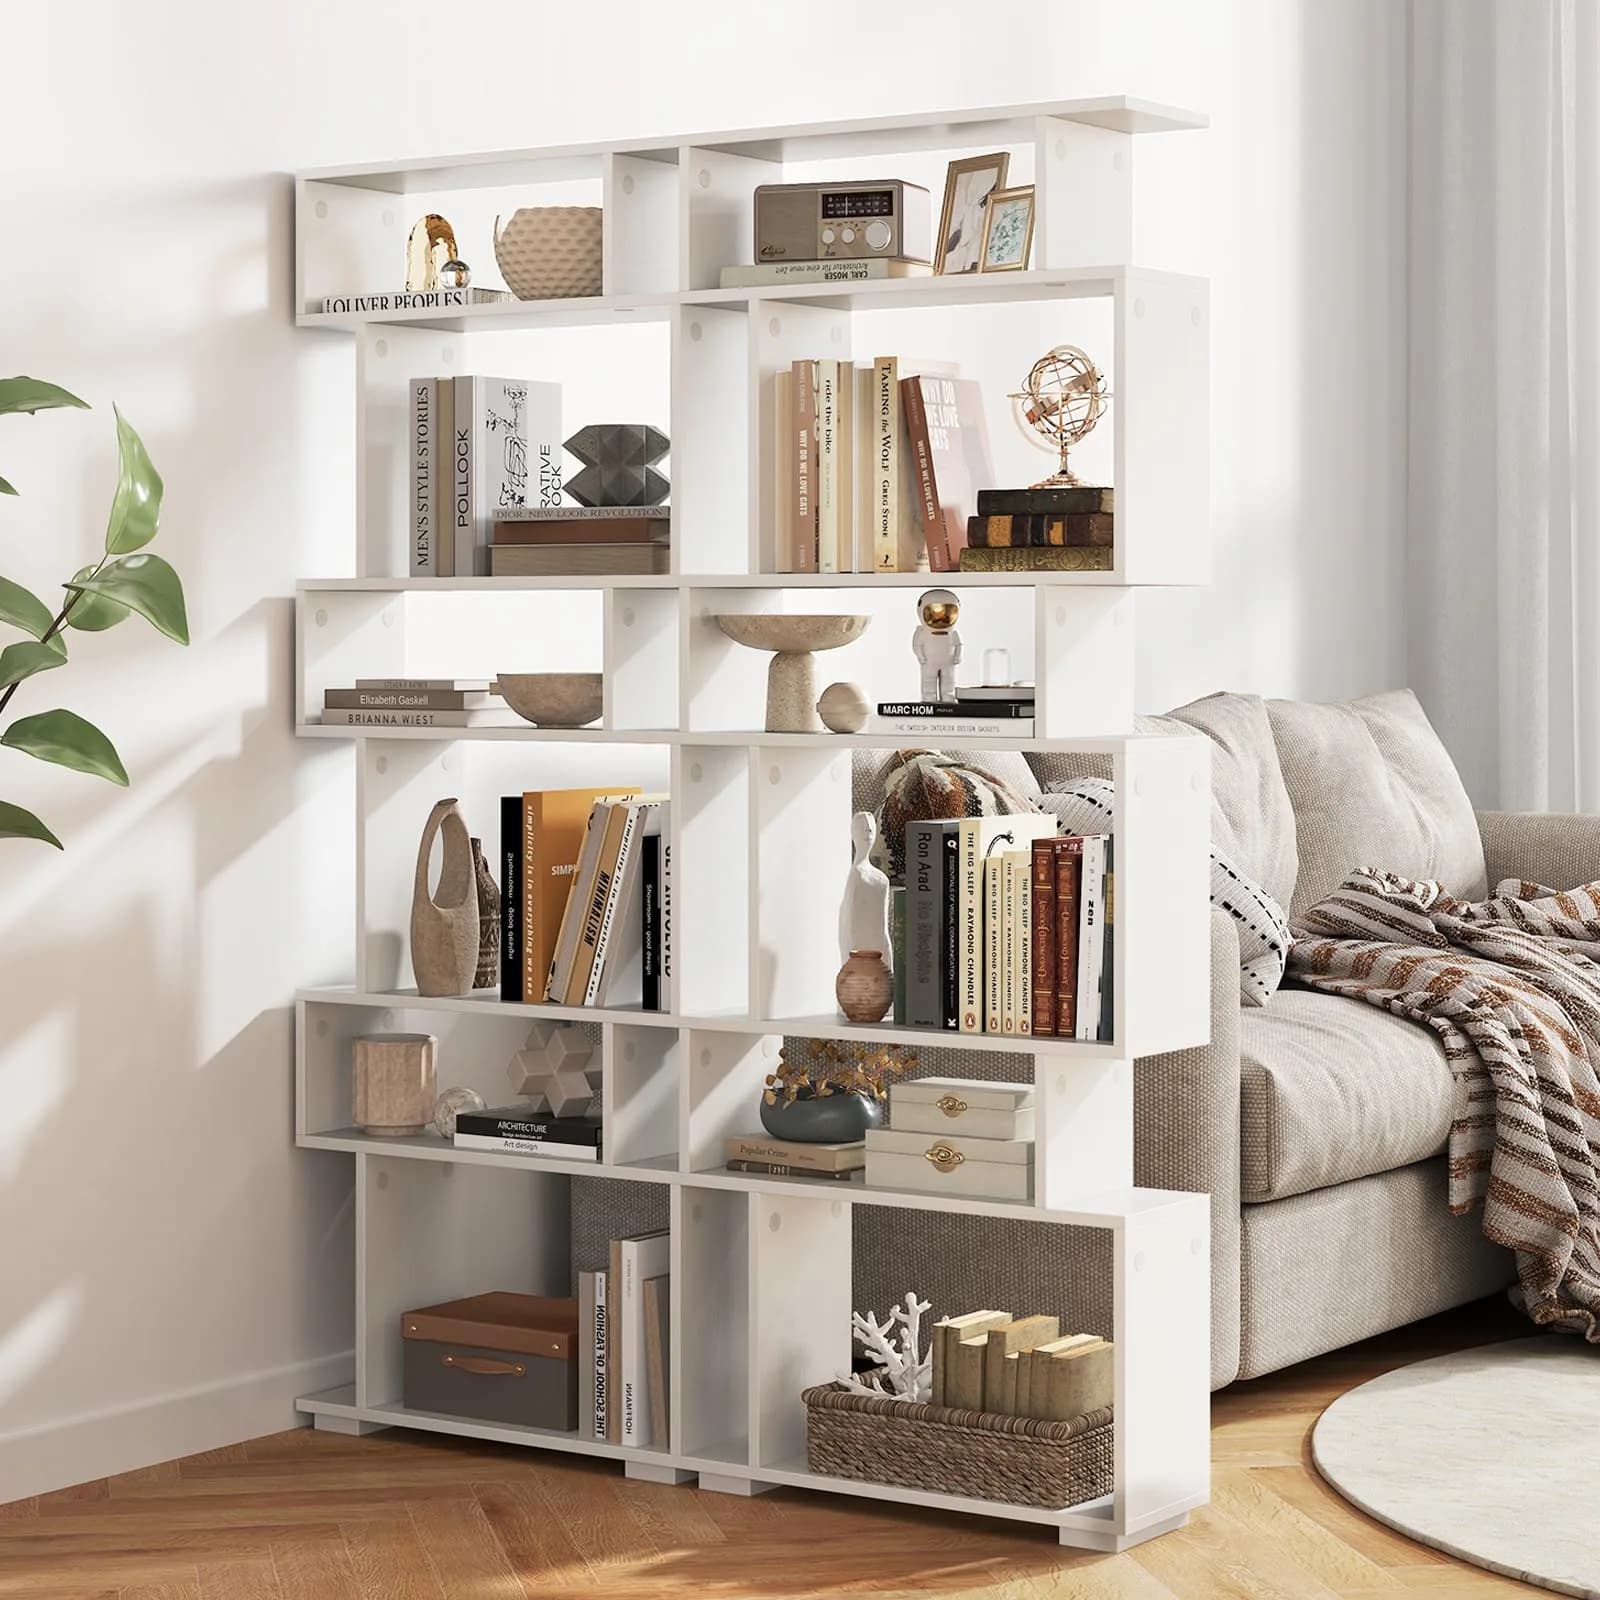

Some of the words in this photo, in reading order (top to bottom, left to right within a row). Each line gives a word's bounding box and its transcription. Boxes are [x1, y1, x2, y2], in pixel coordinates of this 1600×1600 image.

[824, 271, 848, 280] MOSER
[850, 270, 868, 279] CARL
[333, 296, 389, 313] OLIVER
[394, 291, 462, 310] PEOPLES
[881, 363, 892, 416] TAMING
[417, 386, 428, 457] STORIES
[882, 419, 890, 432] the
[800, 430, 808, 446] WHY
[916, 440, 925, 456] WHY
[881, 434, 890, 472] WOLF
[458, 428, 468, 527] POLLOCK
[540, 444, 550, 508] RATIVE
[800, 462, 808, 474] WE
[417, 460, 428, 512] STYLE
[552, 466, 562, 506] OCK
[800, 476, 808, 494] LOVE
[882, 480, 890, 506] GREG
[556, 510, 588, 518] LOOK
[590, 508, 663, 517] REVOLUTION
[800, 496, 808, 516] CATS
[417, 516, 428, 566] MEN'S
[360, 694, 396, 705] Elizabeth
[398, 696, 428, 705] Gaskell
[348, 714, 397, 724] BRIANNA
[402, 715, 434, 725] WIEST
[882, 705, 910, 715] MARC
[912, 706, 934, 716] HOM
[525, 805, 534, 862] simplicity
[616, 819, 633, 872] simplicity
[918, 832, 932, 858] Ron
[527, 866, 534, 875] is
[918, 862, 932, 892] Arad
[527, 878, 534, 890] in
[584, 870, 610, 948] MINIMALISM
[525, 894, 534, 954] everything
[597, 902, 616, 960] everything
[526, 958, 533, 972] we
[498, 1121, 548, 1134] ARCHITECTURE
[504, 1140, 514, 1148] Art
[515, 1142, 538, 1150] design
